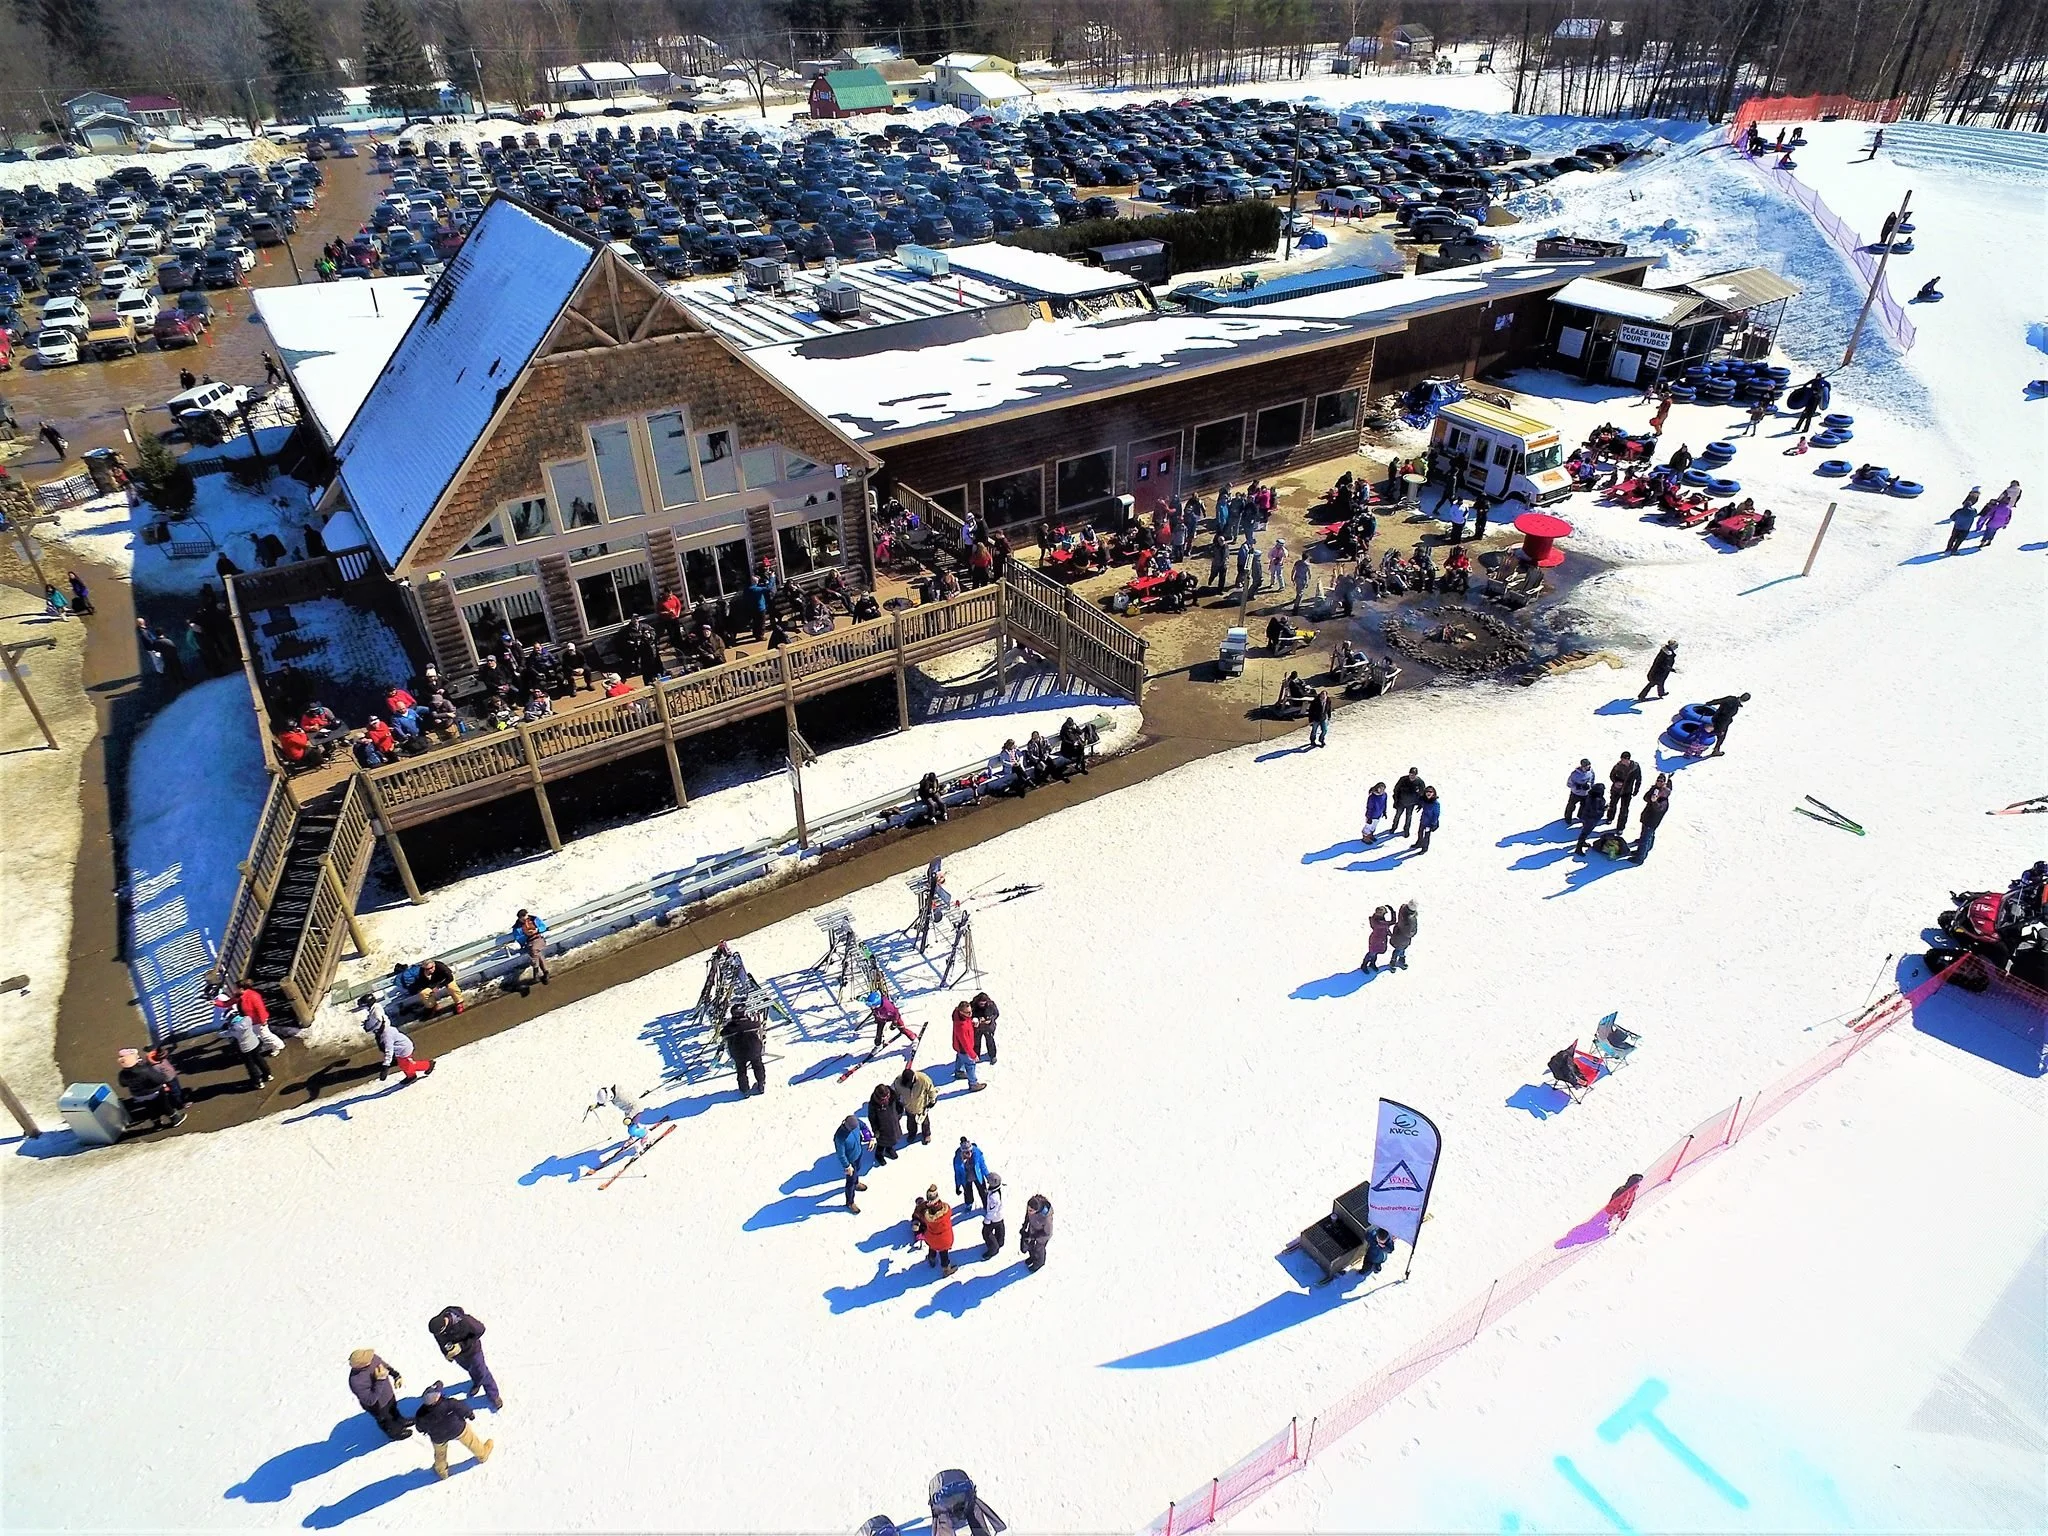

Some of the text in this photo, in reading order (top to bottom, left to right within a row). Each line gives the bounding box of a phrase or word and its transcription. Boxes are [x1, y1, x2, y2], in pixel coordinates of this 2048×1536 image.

[1622, 326, 1670, 341] PLEASE WALK
[1622, 333, 1669, 348] YOUR TUBES!
[1389, 1127, 1419, 1137] KWCC
